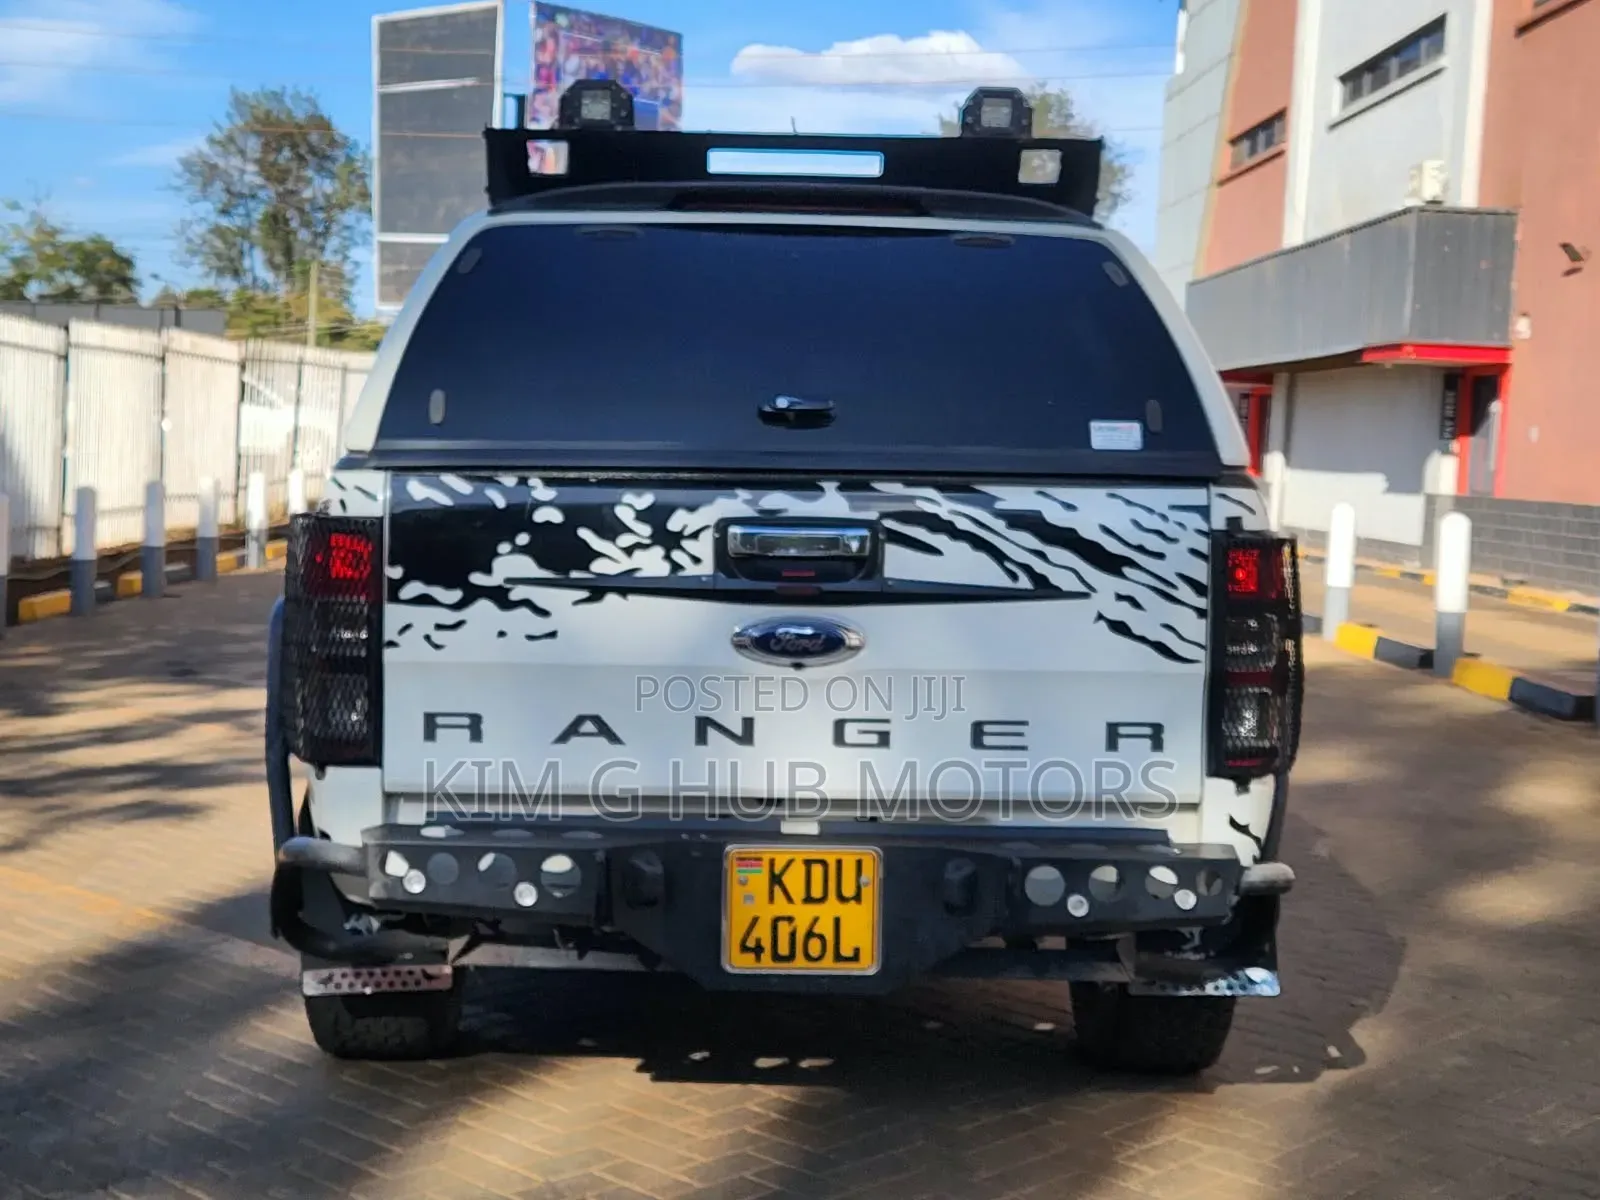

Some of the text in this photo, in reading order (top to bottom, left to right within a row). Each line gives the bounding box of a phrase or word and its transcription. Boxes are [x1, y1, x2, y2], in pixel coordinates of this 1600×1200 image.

[769, 631, 826, 652] Ford
[423, 711, 1165, 753] RANGER
[768, 857, 864, 905] KDU
[739, 915, 861, 963] 406L
